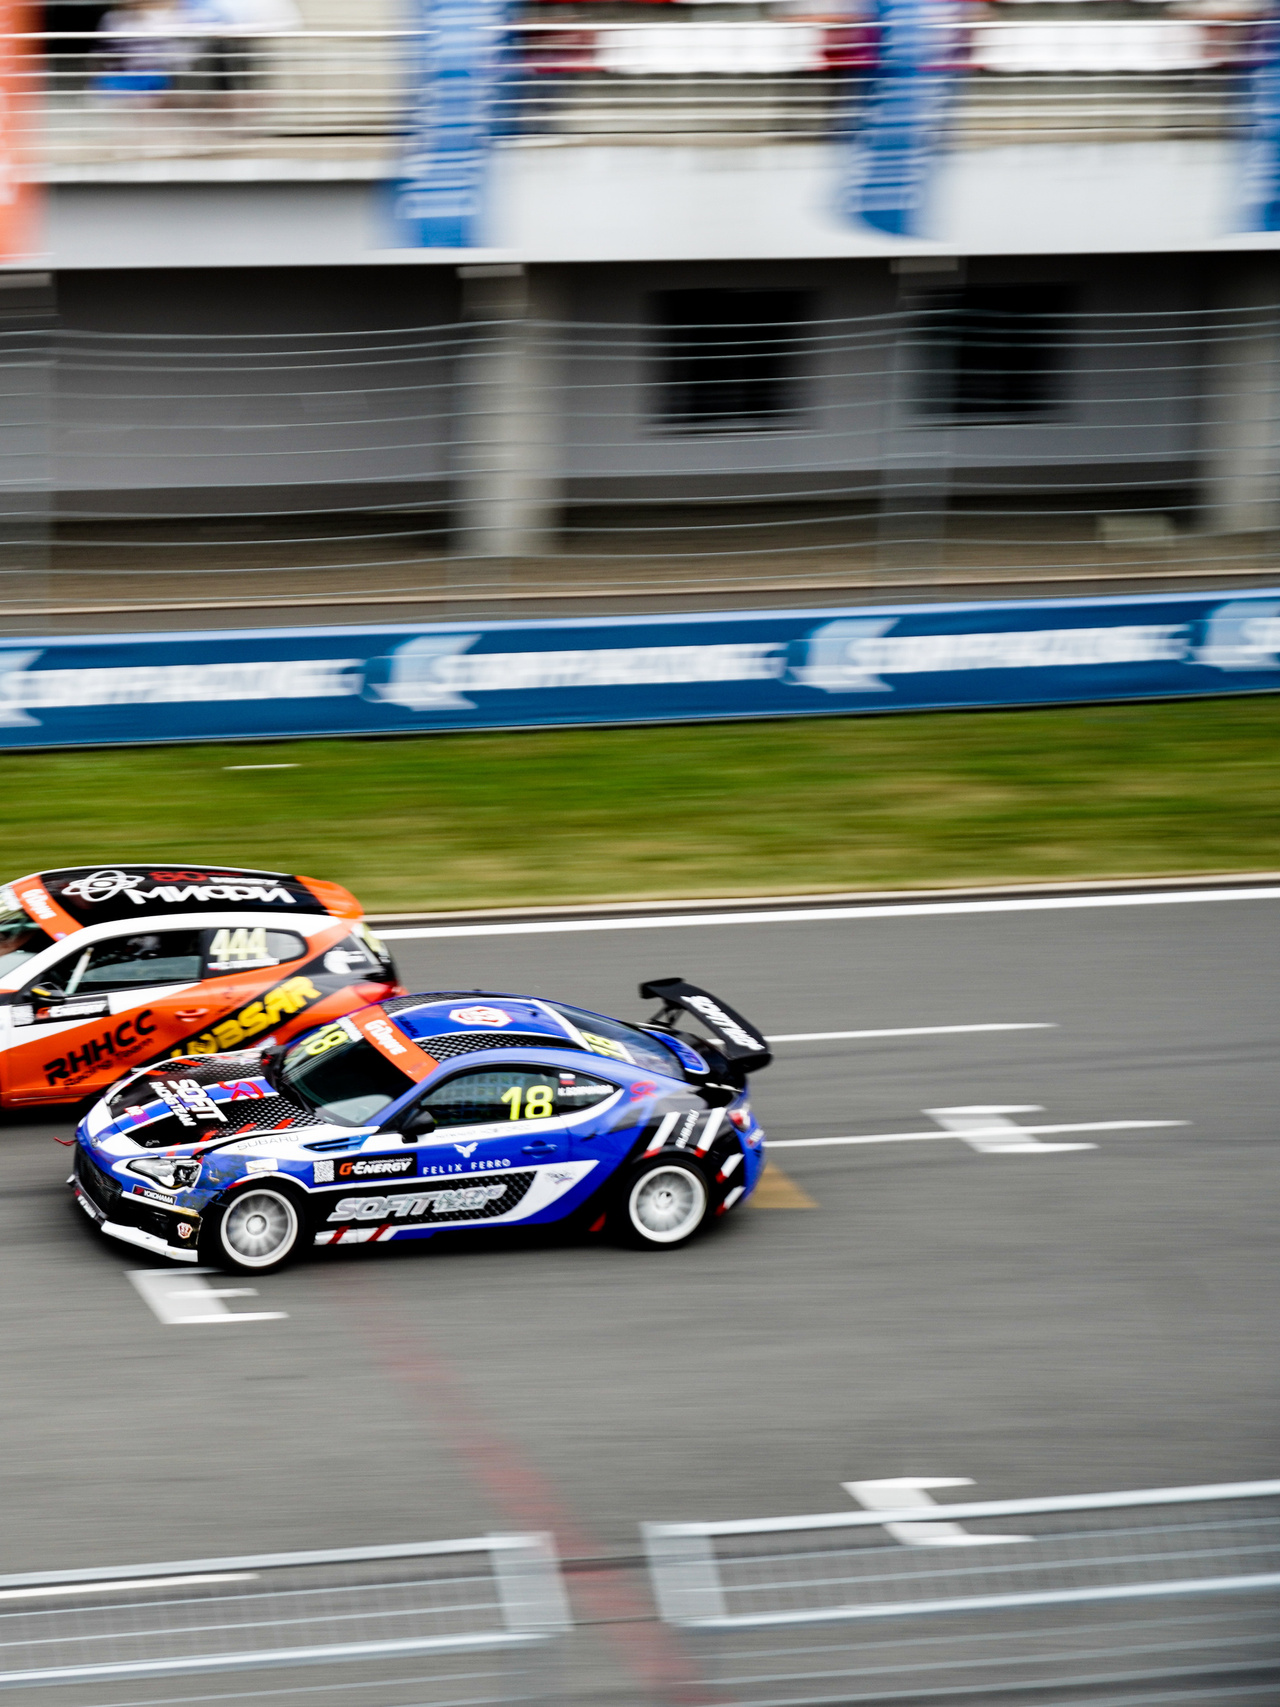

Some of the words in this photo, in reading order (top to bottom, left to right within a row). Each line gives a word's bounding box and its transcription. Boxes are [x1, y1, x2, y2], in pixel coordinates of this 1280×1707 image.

[149, 871, 209, 882] 80
[209, 928, 268, 961] 444
[43, 1009, 157, 1085] RHHCC
[300, 1023, 349, 1056] 18
[167, 1079, 229, 1122] SOFIT
[500, 1085, 554, 1121] 18
[172, 1104, 197, 1126] TEAM
[237, 1135, 299, 1151] SUBARU
[422, 1163, 463, 1175] FELIX
[471, 1158, 511, 1170] FERRO
[143, 1189, 174, 1204] YOKOHAMA
[326, 1193, 439, 1222] SOFIT
